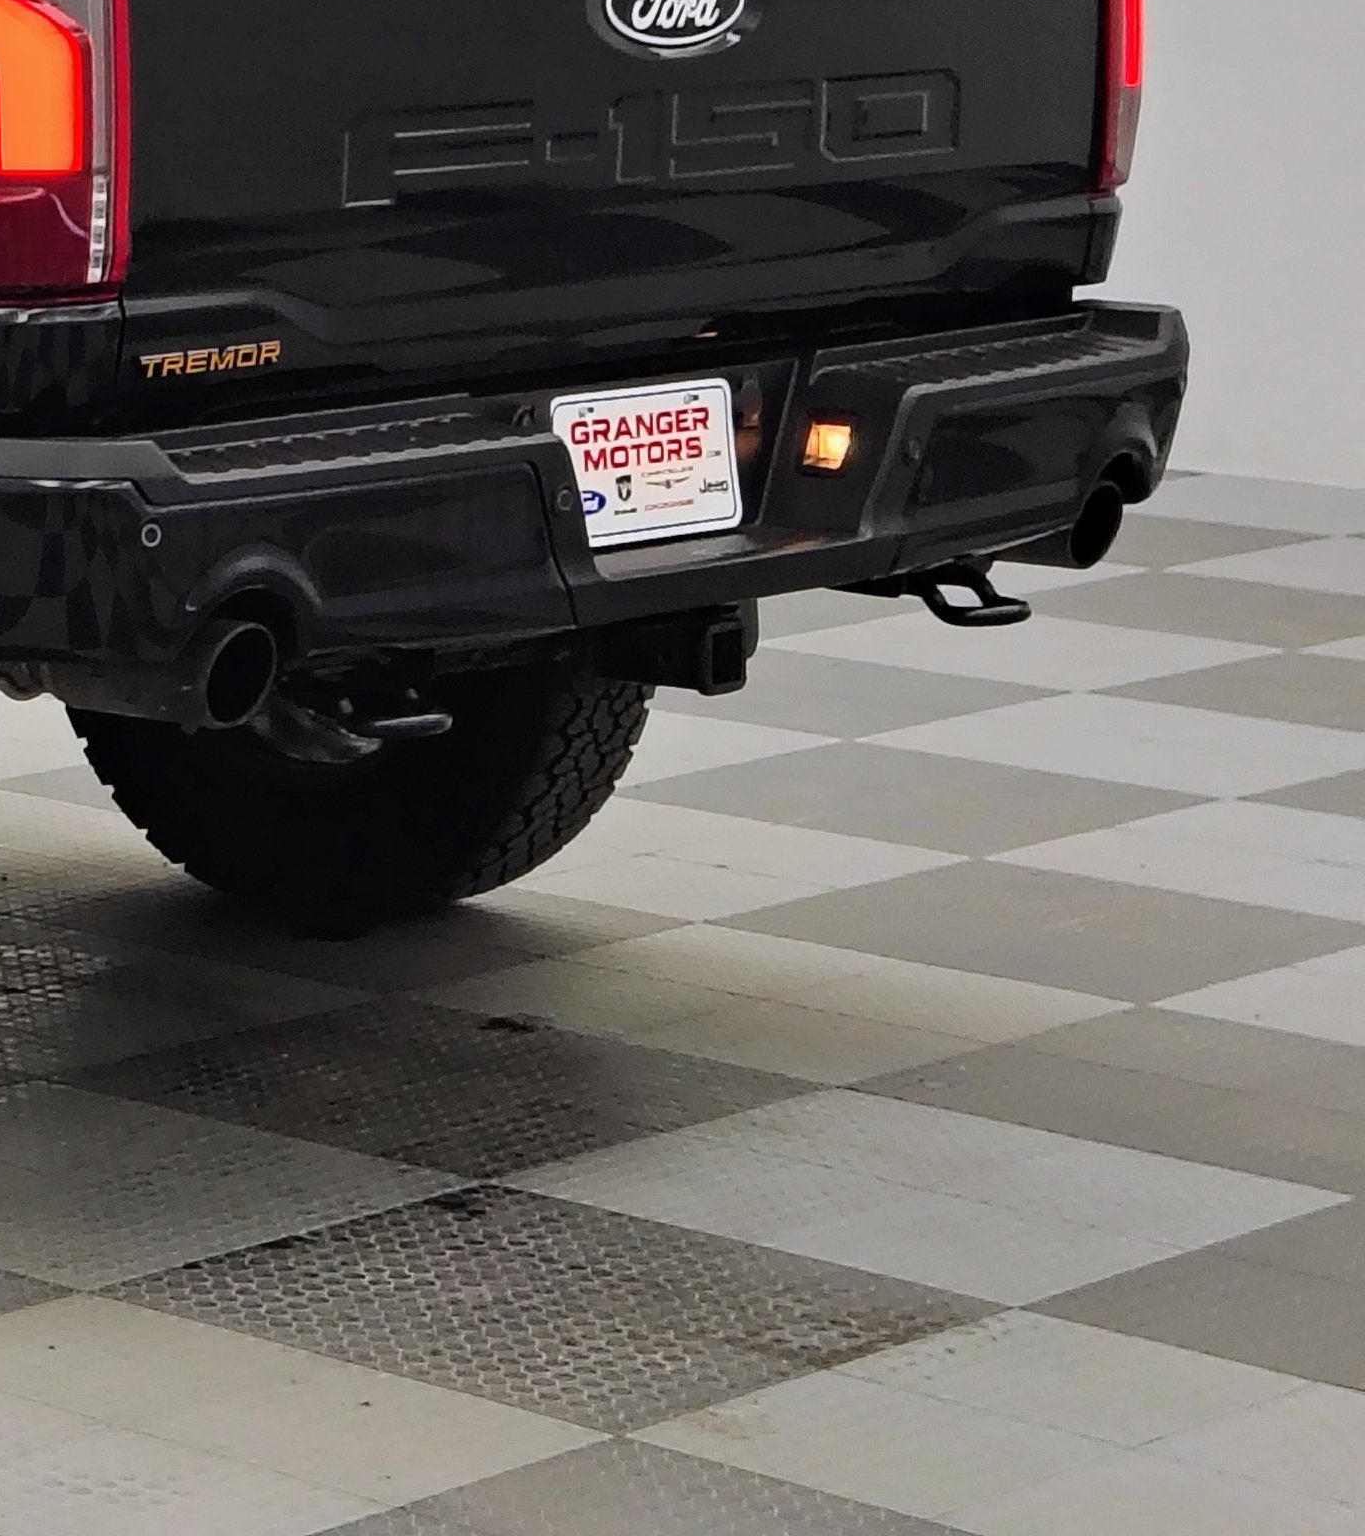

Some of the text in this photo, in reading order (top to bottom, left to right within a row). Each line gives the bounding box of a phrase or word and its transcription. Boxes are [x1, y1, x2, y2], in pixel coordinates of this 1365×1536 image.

[342, 67, 962, 209] F-150
[139, 340, 282, 379] TREMOR
[570, 406, 711, 446] GRANGER
[583, 436, 703, 473] MOTORS
